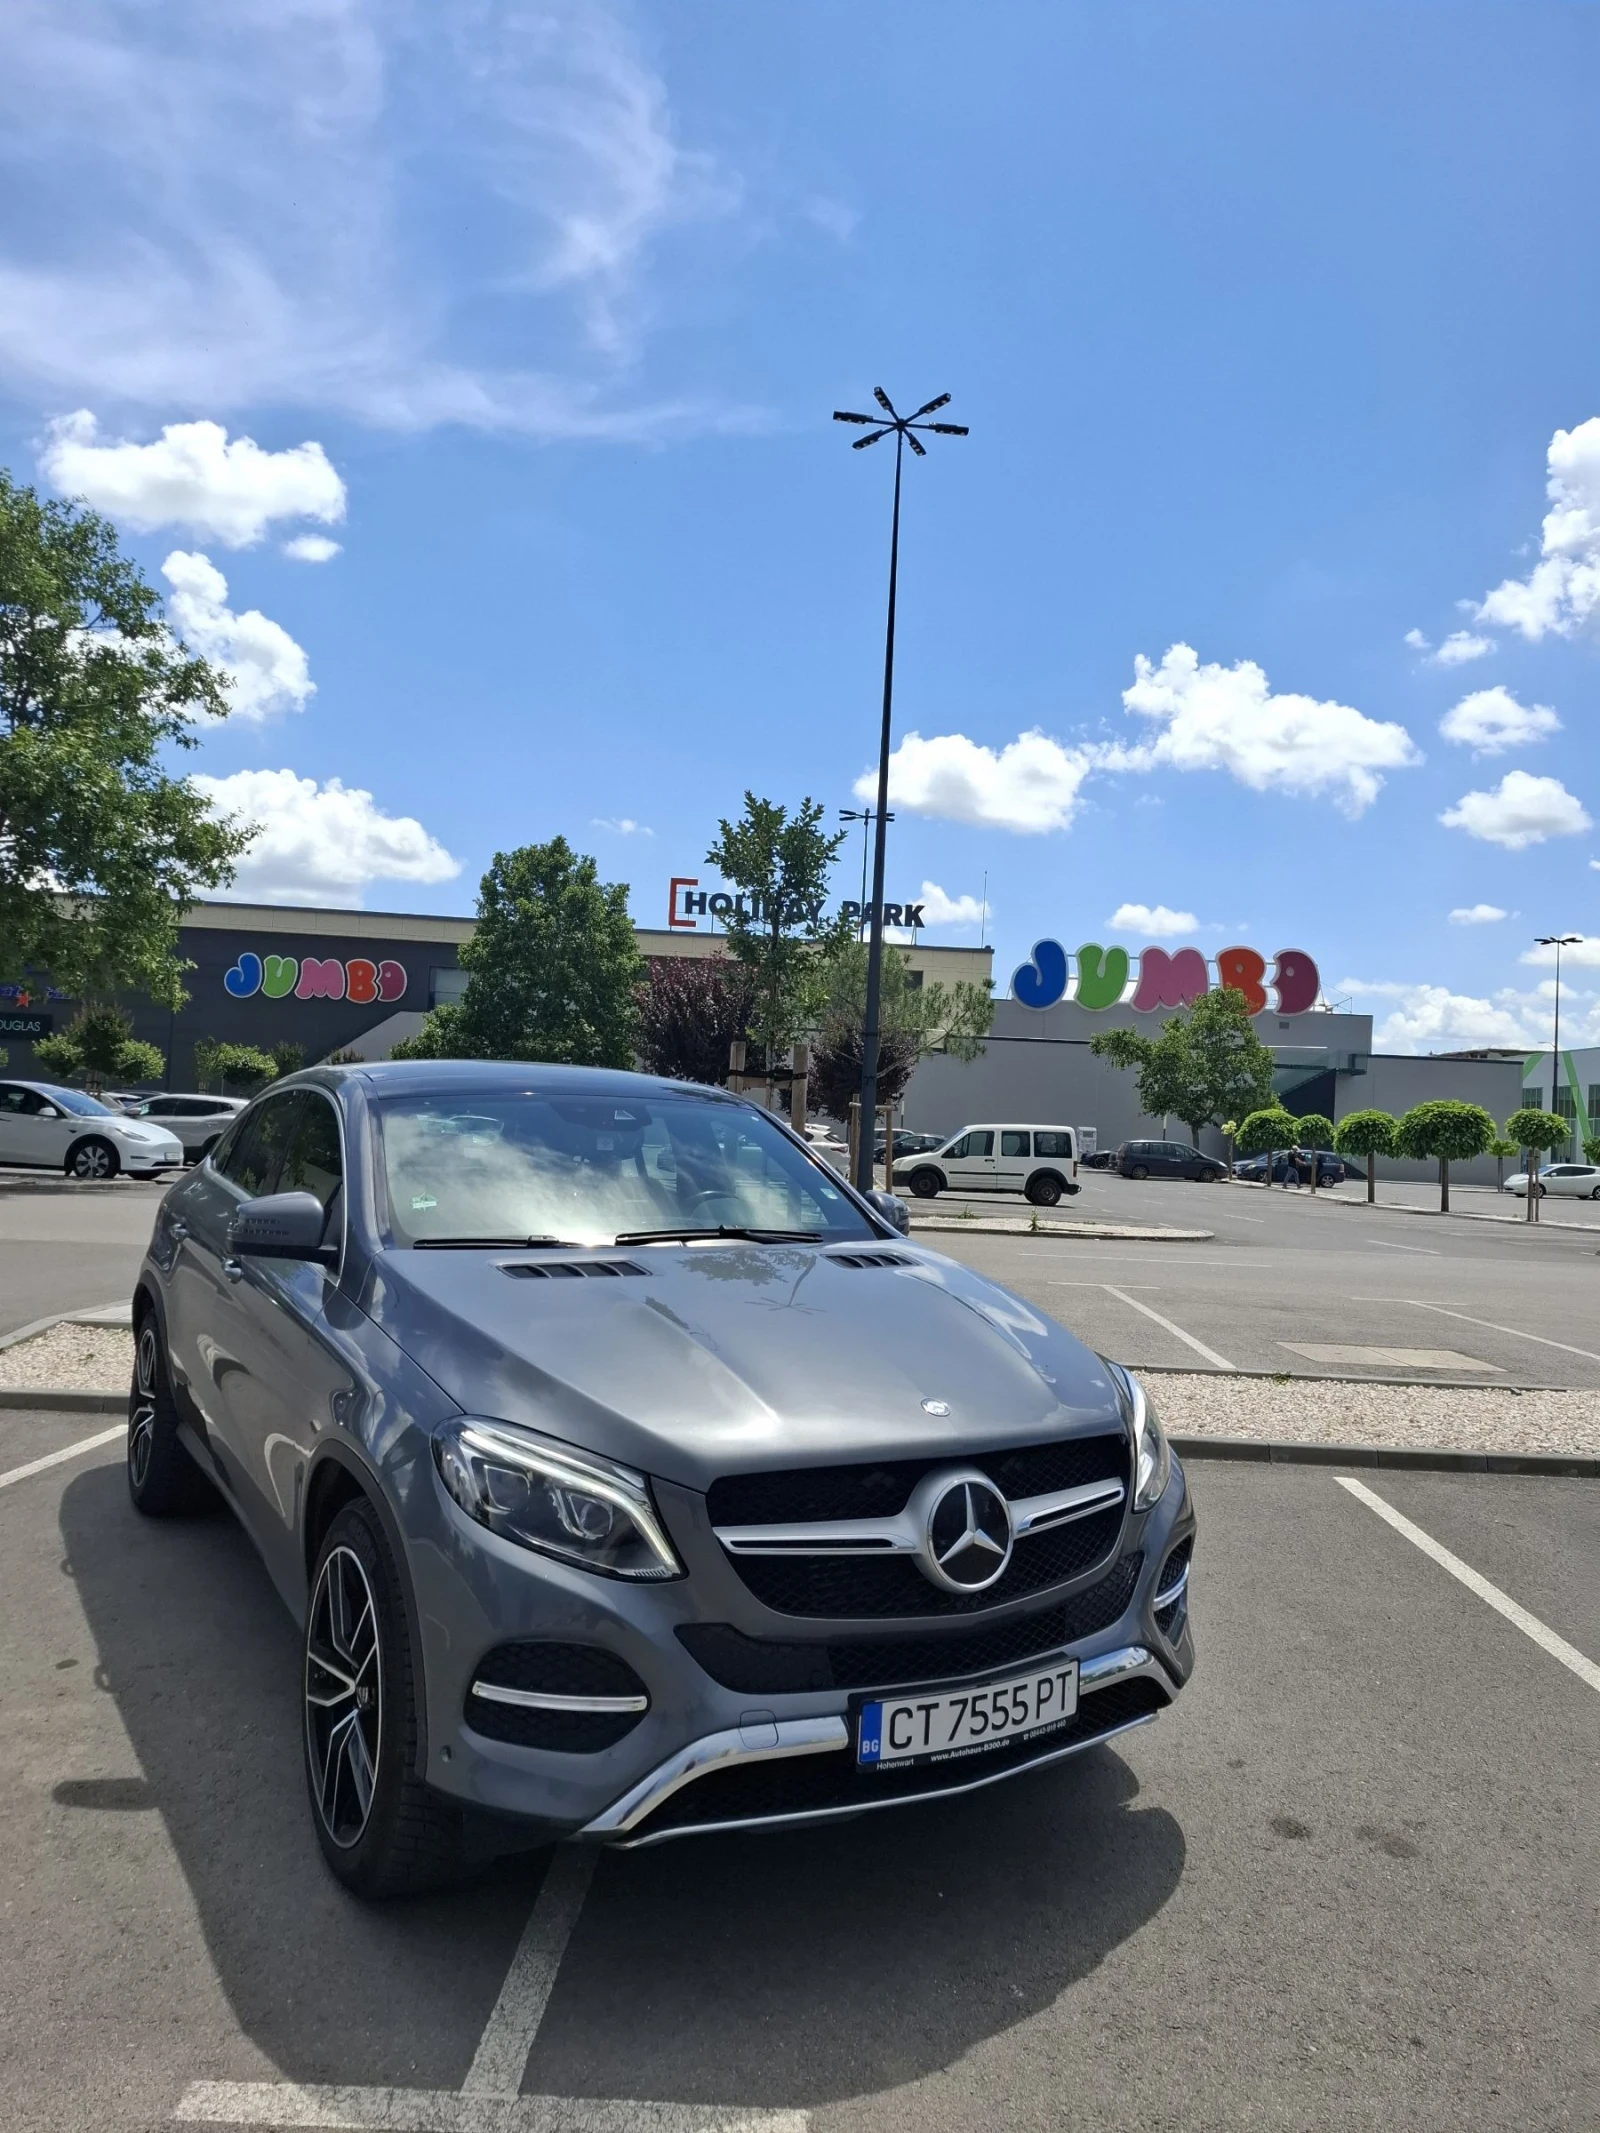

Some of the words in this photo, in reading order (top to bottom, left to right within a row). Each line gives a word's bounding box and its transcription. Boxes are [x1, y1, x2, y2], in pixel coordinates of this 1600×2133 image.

[685, 891, 826, 927] HOLIAY
[224, 953, 407, 1004] JUMBO
[1011, 938, 1321, 1018] JUMBO
[889, 1702, 940, 1750] CT
[948, 1683, 1029, 1742] 7555
[1036, 1670, 1073, 1720] PT
[862, 1739, 879, 1754] BG
[876, 1758, 915, 1771] Hohenwart
